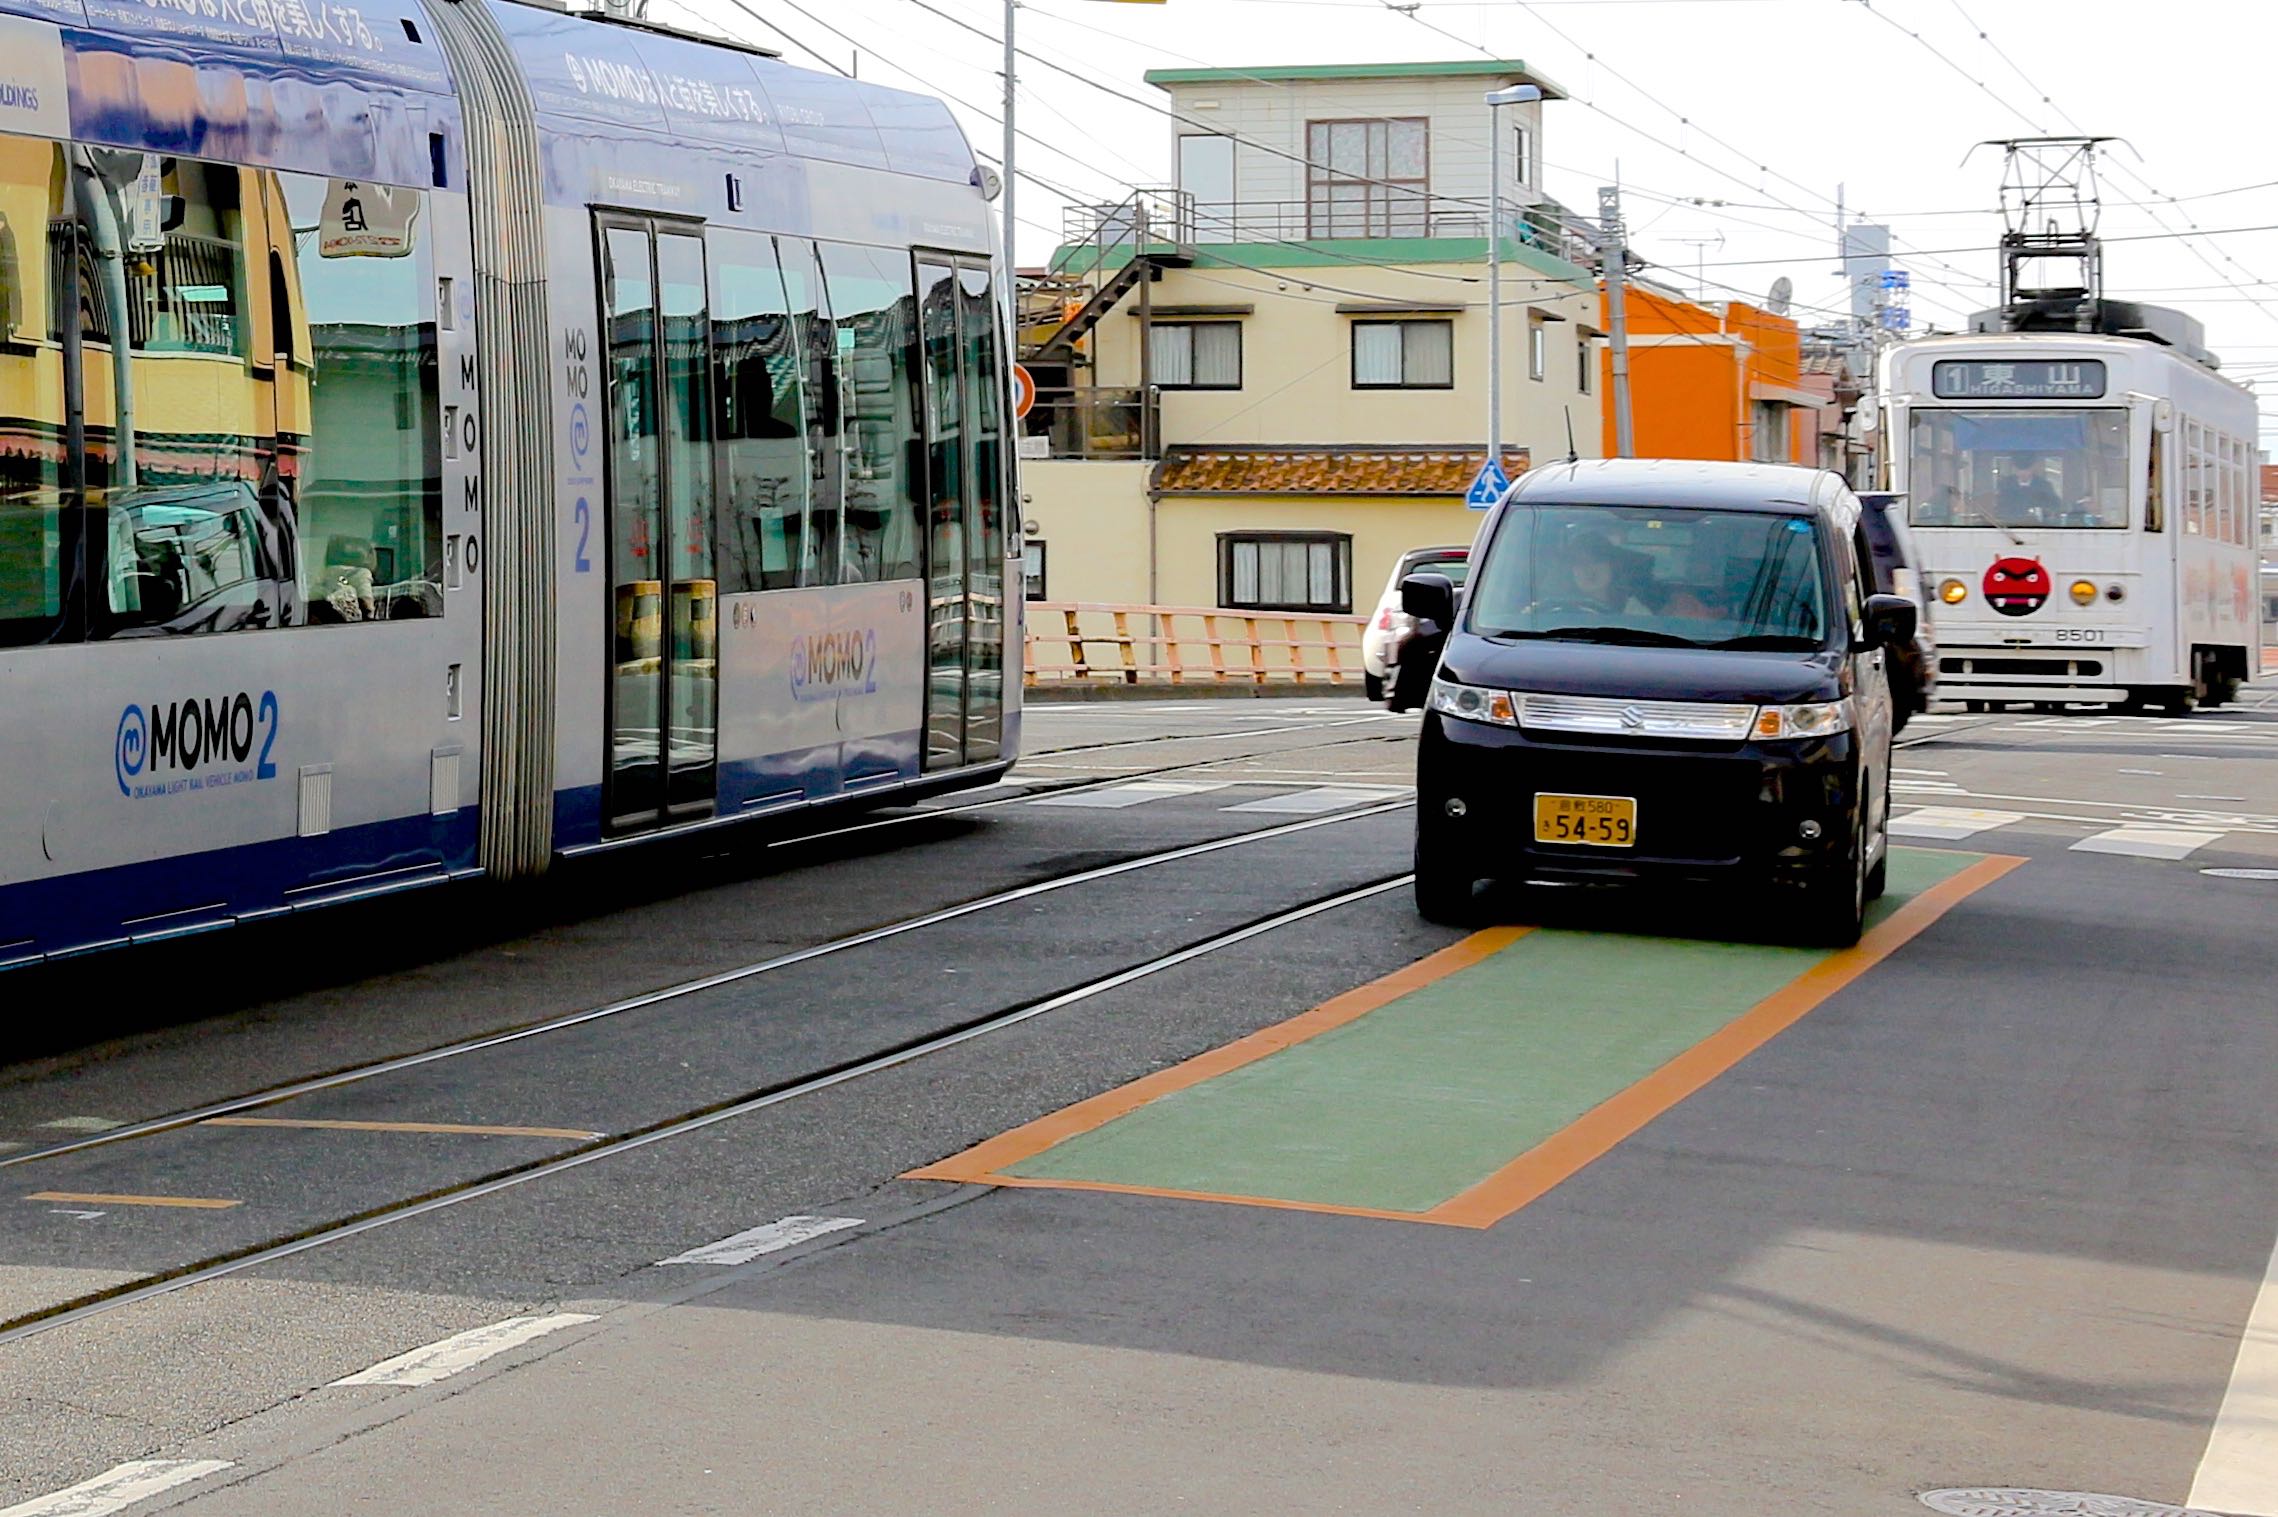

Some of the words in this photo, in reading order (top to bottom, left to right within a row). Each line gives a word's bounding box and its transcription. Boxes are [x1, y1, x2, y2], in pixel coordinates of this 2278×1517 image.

[1948, 366, 1963, 391] 1
[1971, 384, 2094, 395] HIGASHIYAMA
[574, 497, 591, 573] 2
[2056, 629, 2104, 642] 8501
[133, 783, 166, 799] OKAYAMA
[167, 779, 187, 794] LIGHT
[189, 777, 204, 791] RAIL
[206, 772, 231, 788] VEHICLE
[1588, 801, 1613, 813] 580
[1556, 815, 1630, 841] 54-59
